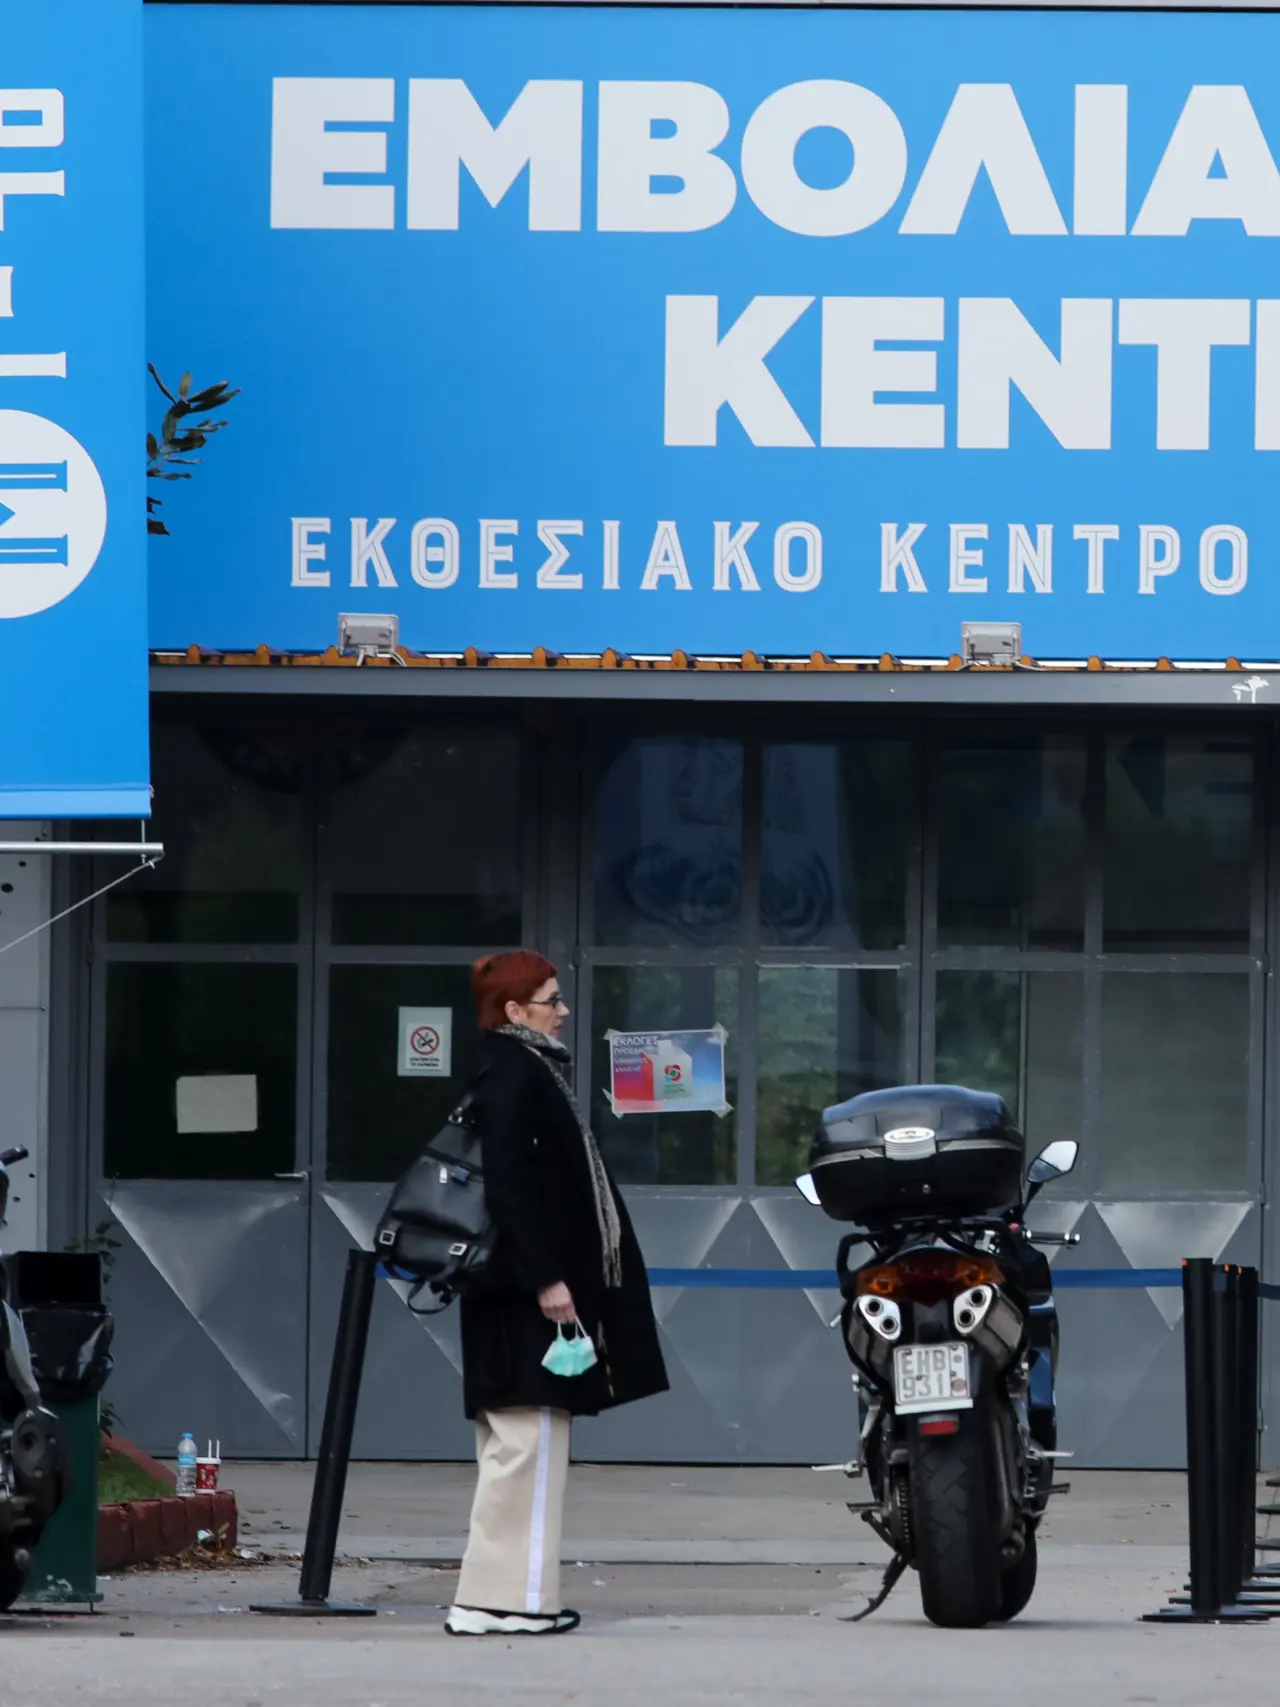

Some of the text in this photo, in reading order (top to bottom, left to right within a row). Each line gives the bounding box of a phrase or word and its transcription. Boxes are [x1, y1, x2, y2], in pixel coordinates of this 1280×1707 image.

[290, 517, 824, 592] ΕΚΘΕΣΙΑΚΟ
[880, 522, 1249, 595] ΚΕΝΤΡΟ
[902, 1374, 944, 1399] 931
